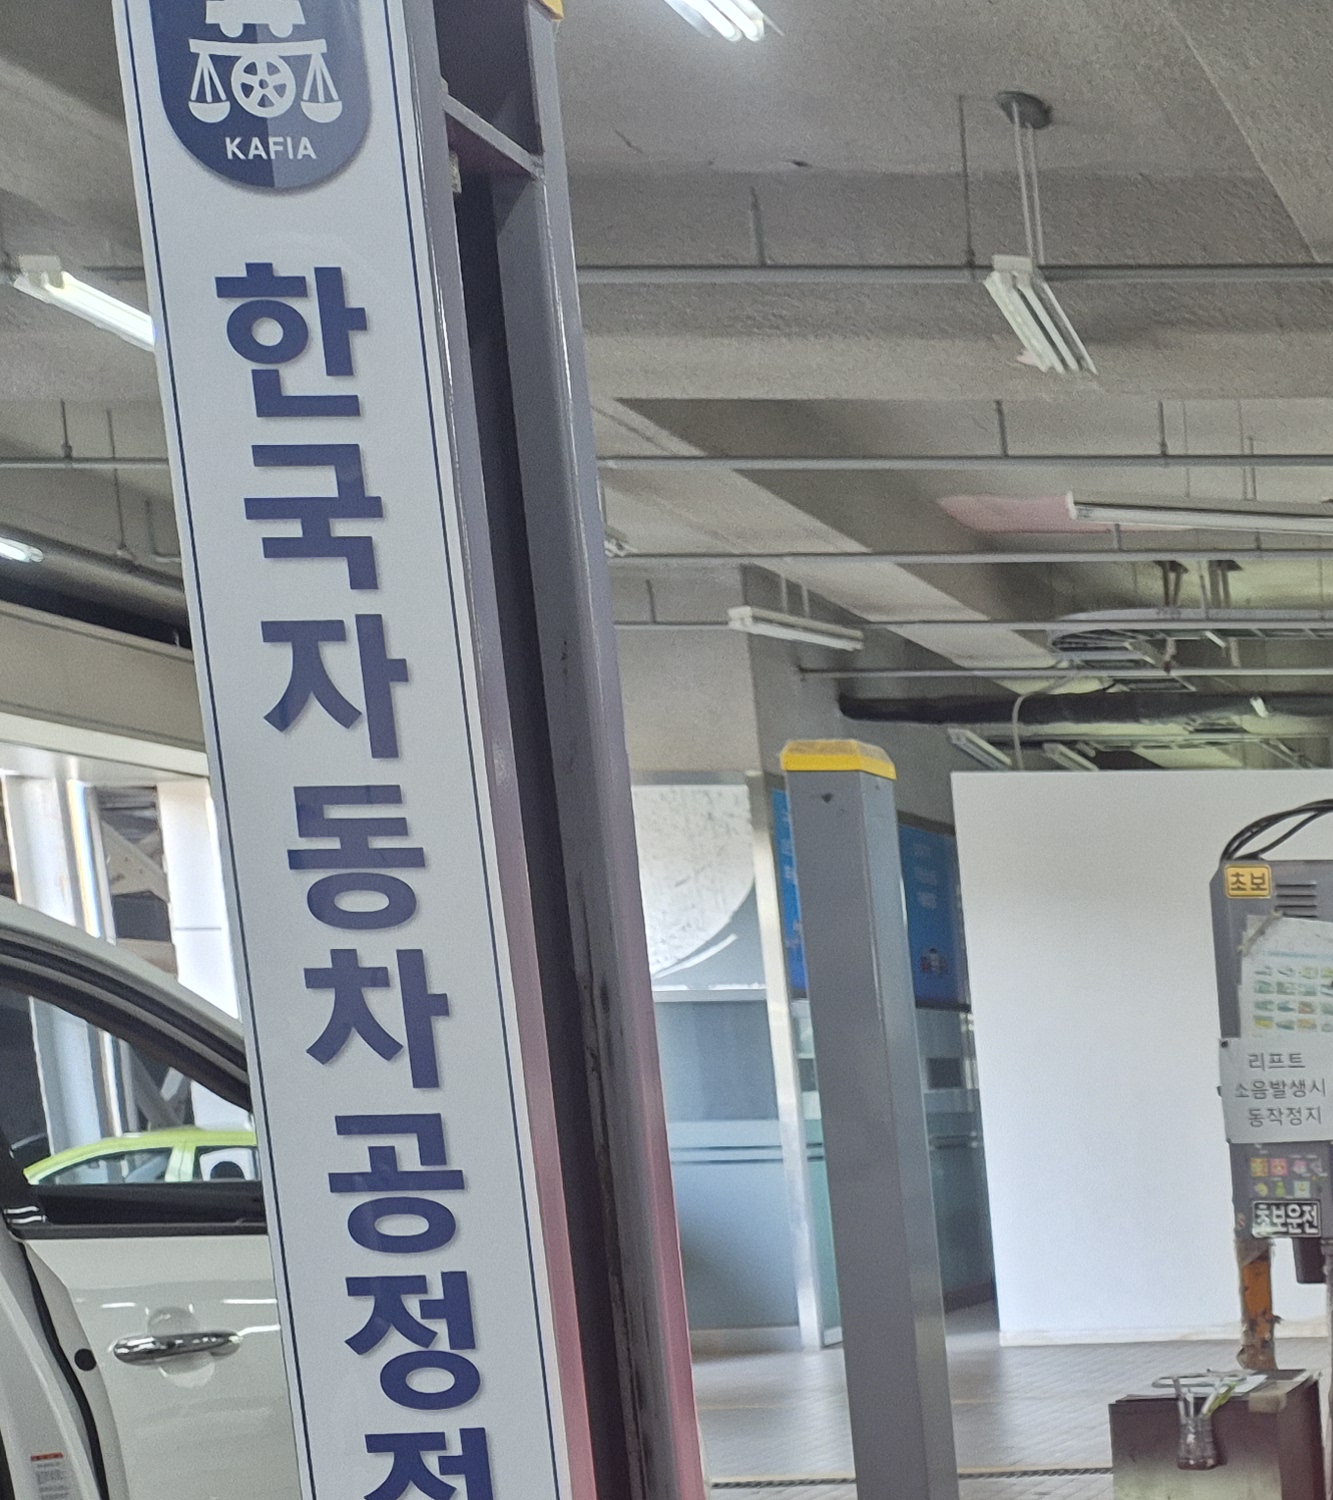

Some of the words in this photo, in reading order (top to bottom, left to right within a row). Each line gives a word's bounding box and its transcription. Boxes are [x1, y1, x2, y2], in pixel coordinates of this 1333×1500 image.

[225, 136, 317, 160] KAFIA
[1230, 872, 1268, 891] 초보
[1248, 1053, 1306, 1072] 리프트
[1235, 1078, 1327, 1100] 소음발생시
[1248, 1106, 1322, 1128] 동작정지
[1254, 1204, 1320, 1235] 초보운전
